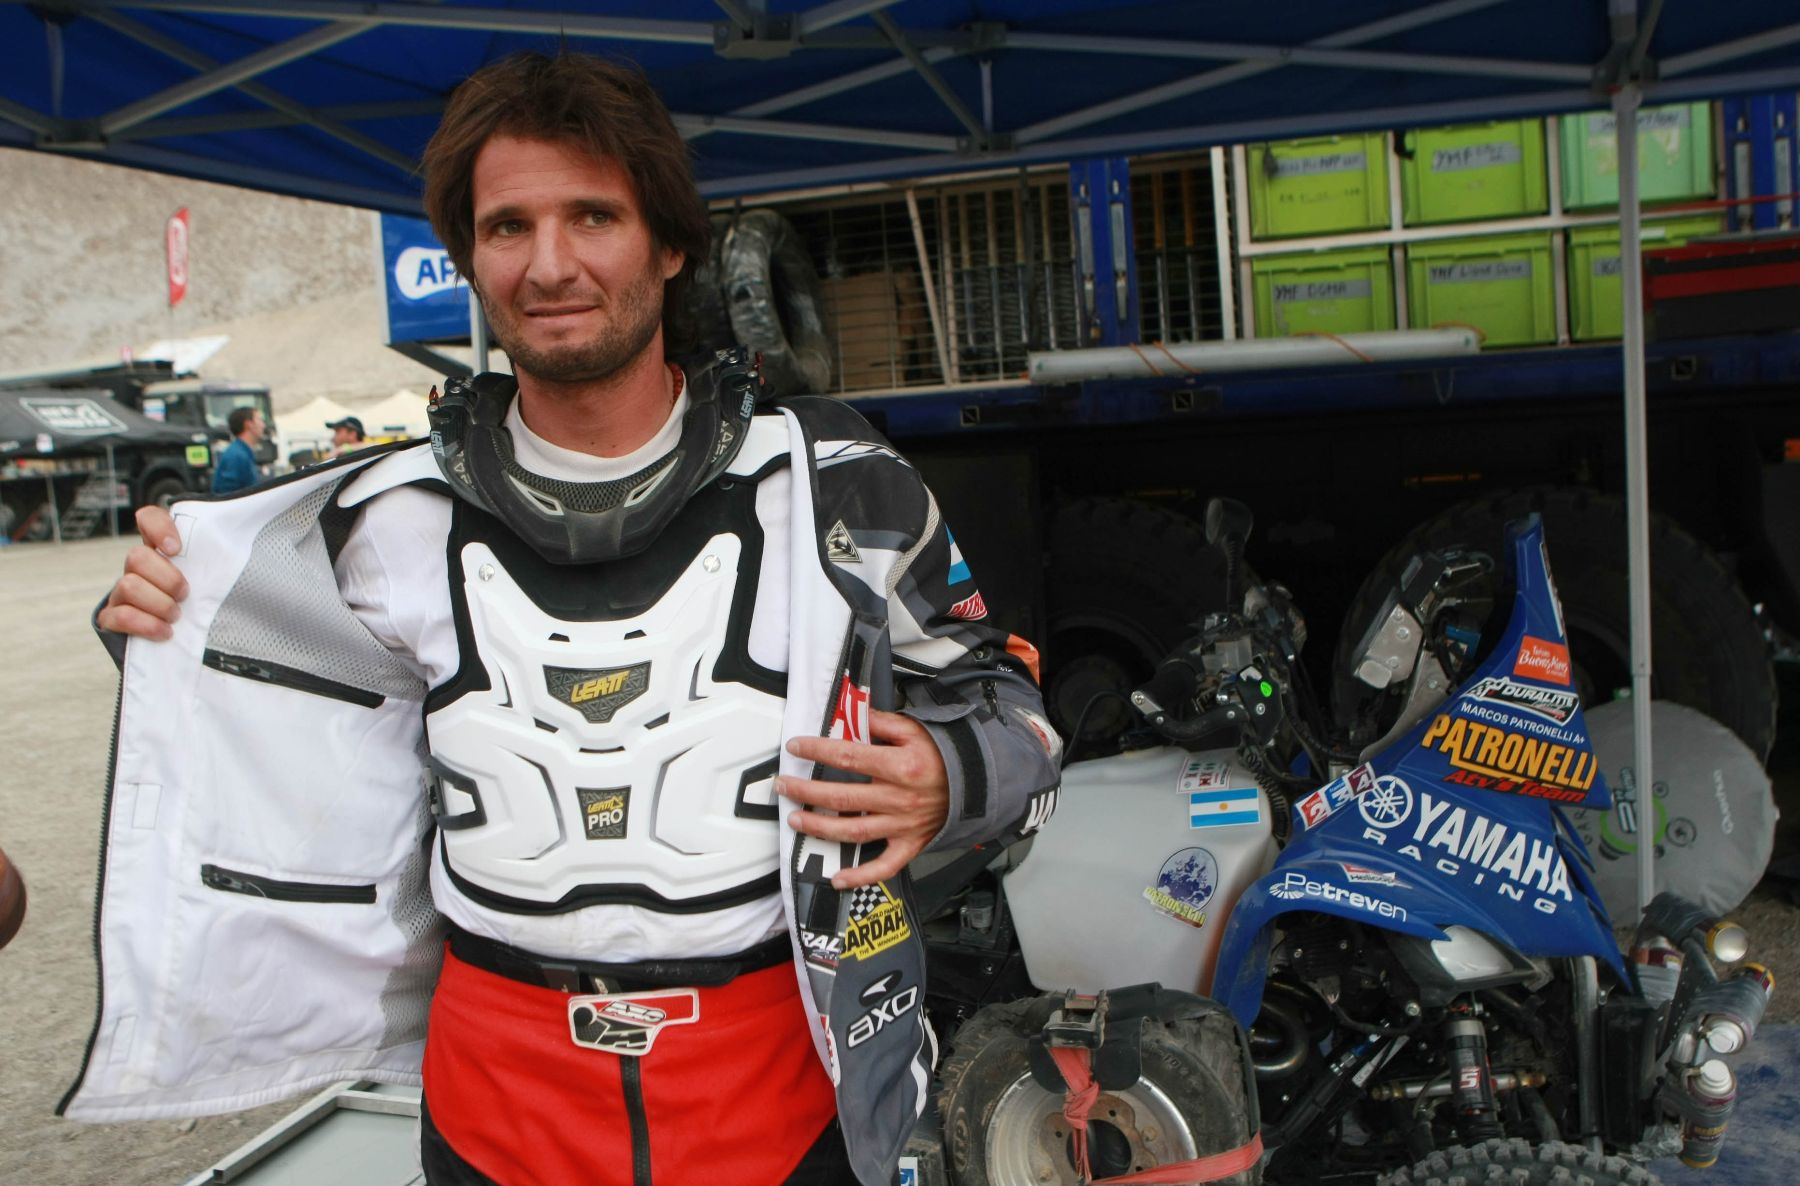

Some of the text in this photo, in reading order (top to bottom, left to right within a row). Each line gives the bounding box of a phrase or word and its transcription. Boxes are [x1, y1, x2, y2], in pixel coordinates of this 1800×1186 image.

[570, 670, 630, 704] LEATT
[1461, 702, 1508, 724] MARCOS
[1509, 716, 1573, 743] PATRONELLI
[1421, 714, 1598, 790] PATRONELLI
[587, 808, 624, 830] PRO
[1362, 827, 1557, 915] RACING
[1413, 793, 1573, 902] YAMAHA
[1285, 872, 1408, 923] Petreven
